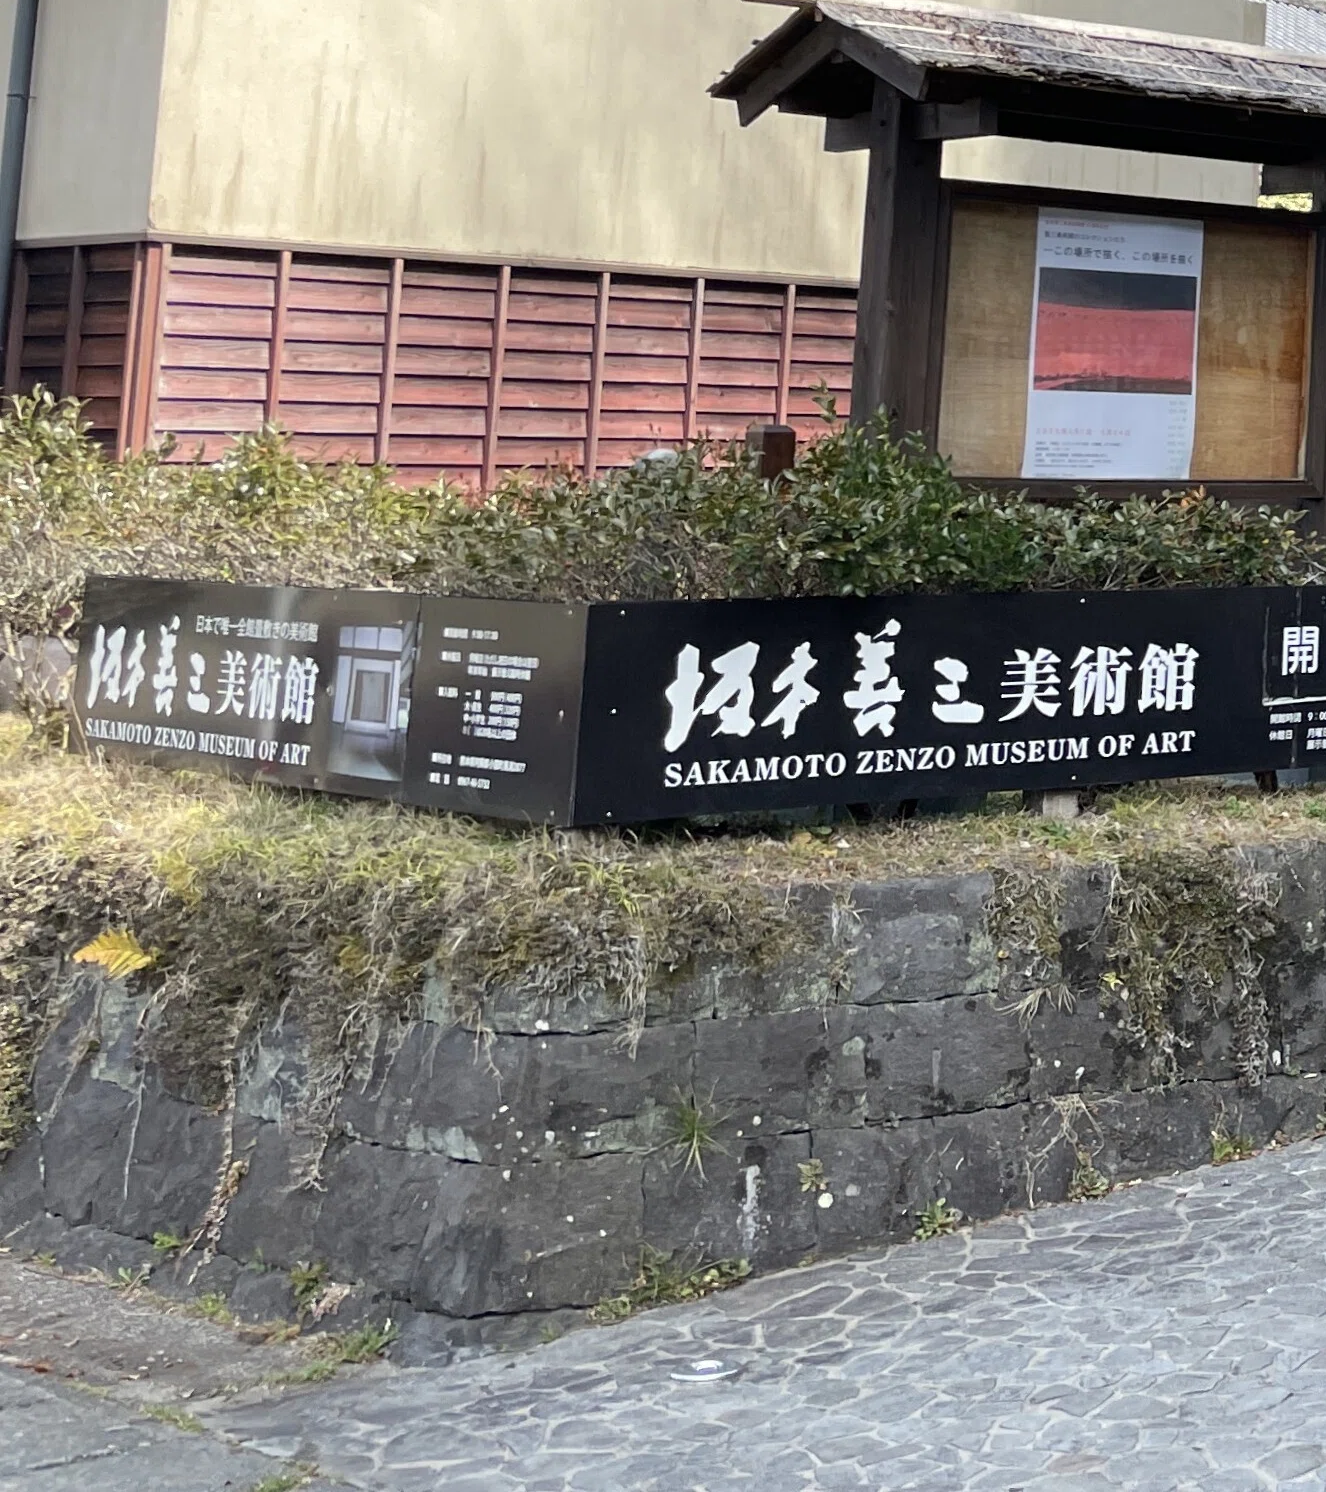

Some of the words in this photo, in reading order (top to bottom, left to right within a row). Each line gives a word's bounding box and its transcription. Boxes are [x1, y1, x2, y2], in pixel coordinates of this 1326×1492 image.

[85, 615, 320, 725] 坂本善三美術館
[663, 618, 1200, 753] 坂本善三美術館
[85, 717, 152, 746] SAKAMOTO
[154, 727, 196, 752] ZENZO
[198, 732, 256, 759] MUSEUM
[258, 739, 279, 762] OF
[279, 744, 312, 767] ART
[663, 752, 847, 788] SAKAMOTO
[855, 745, 956, 775] ZENZO
[964, 736, 1090, 767] MUSEUM
[1097, 734, 1136, 758] OF
[1142, 730, 1196, 755] ART
